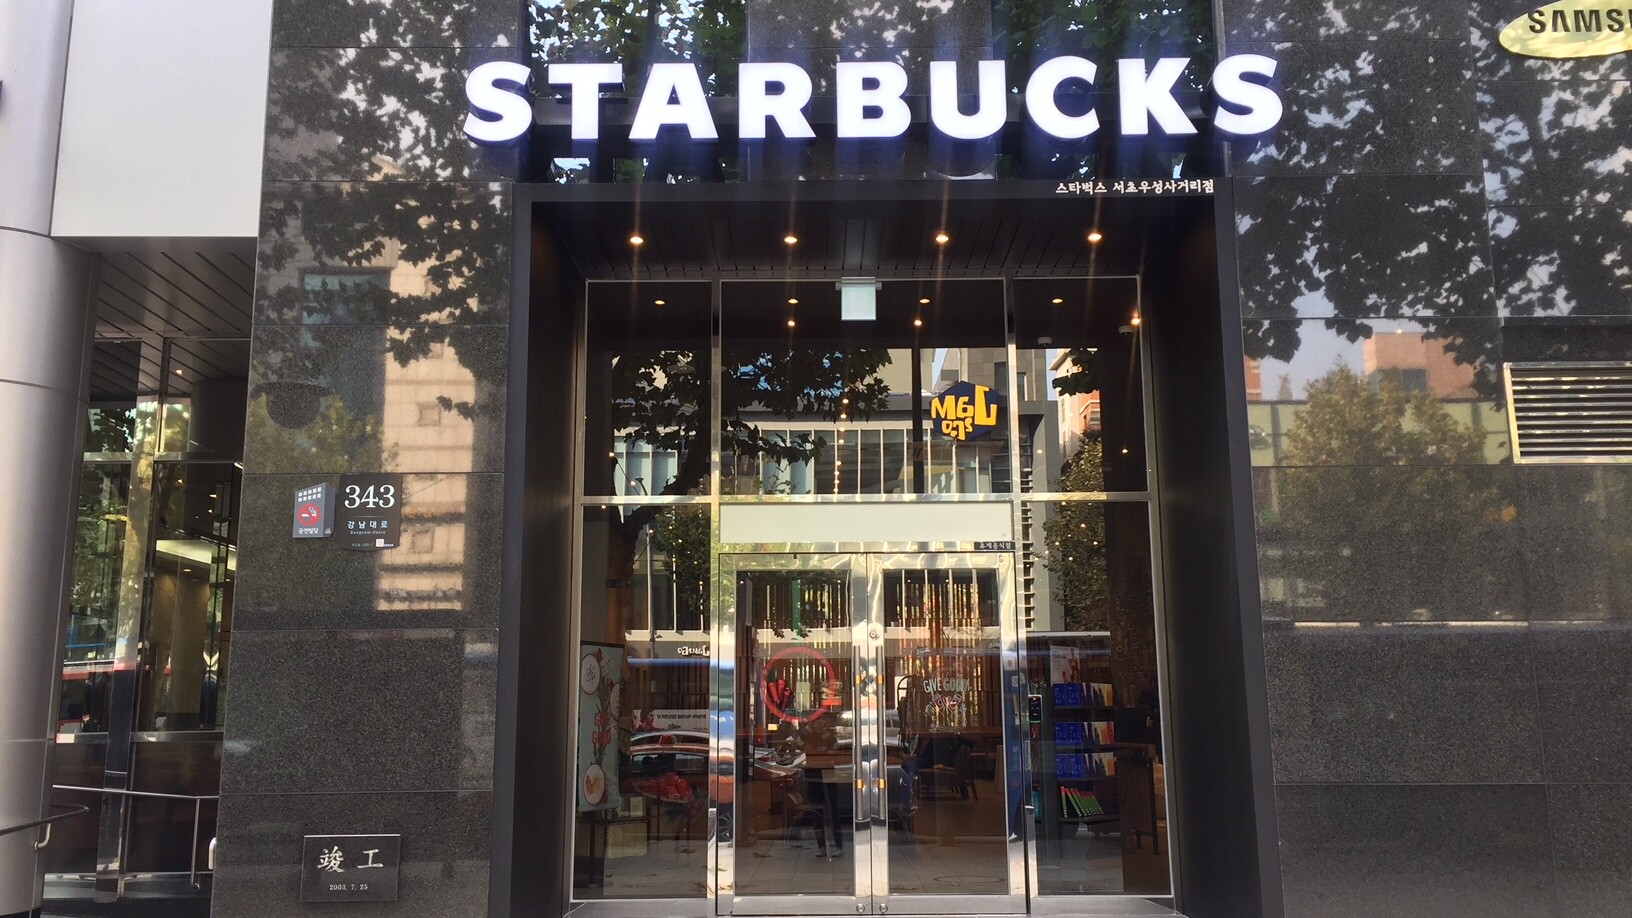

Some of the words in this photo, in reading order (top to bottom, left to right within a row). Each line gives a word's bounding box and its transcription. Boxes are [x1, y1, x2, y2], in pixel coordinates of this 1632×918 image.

[1527, 8, 1632, 33] SAMS
[463, 55, 1284, 143] STARBUCKS
[1055, 181, 1107, 194] 스타벅스
[1112, 179, 1215, 194] 서초우성사거리점
[344, 484, 395, 508] 343
[347, 520, 388, 529] 강남대로
[979, 542, 1011, 550] 휴게음식점
[923, 678, 942, 693] GIVE
